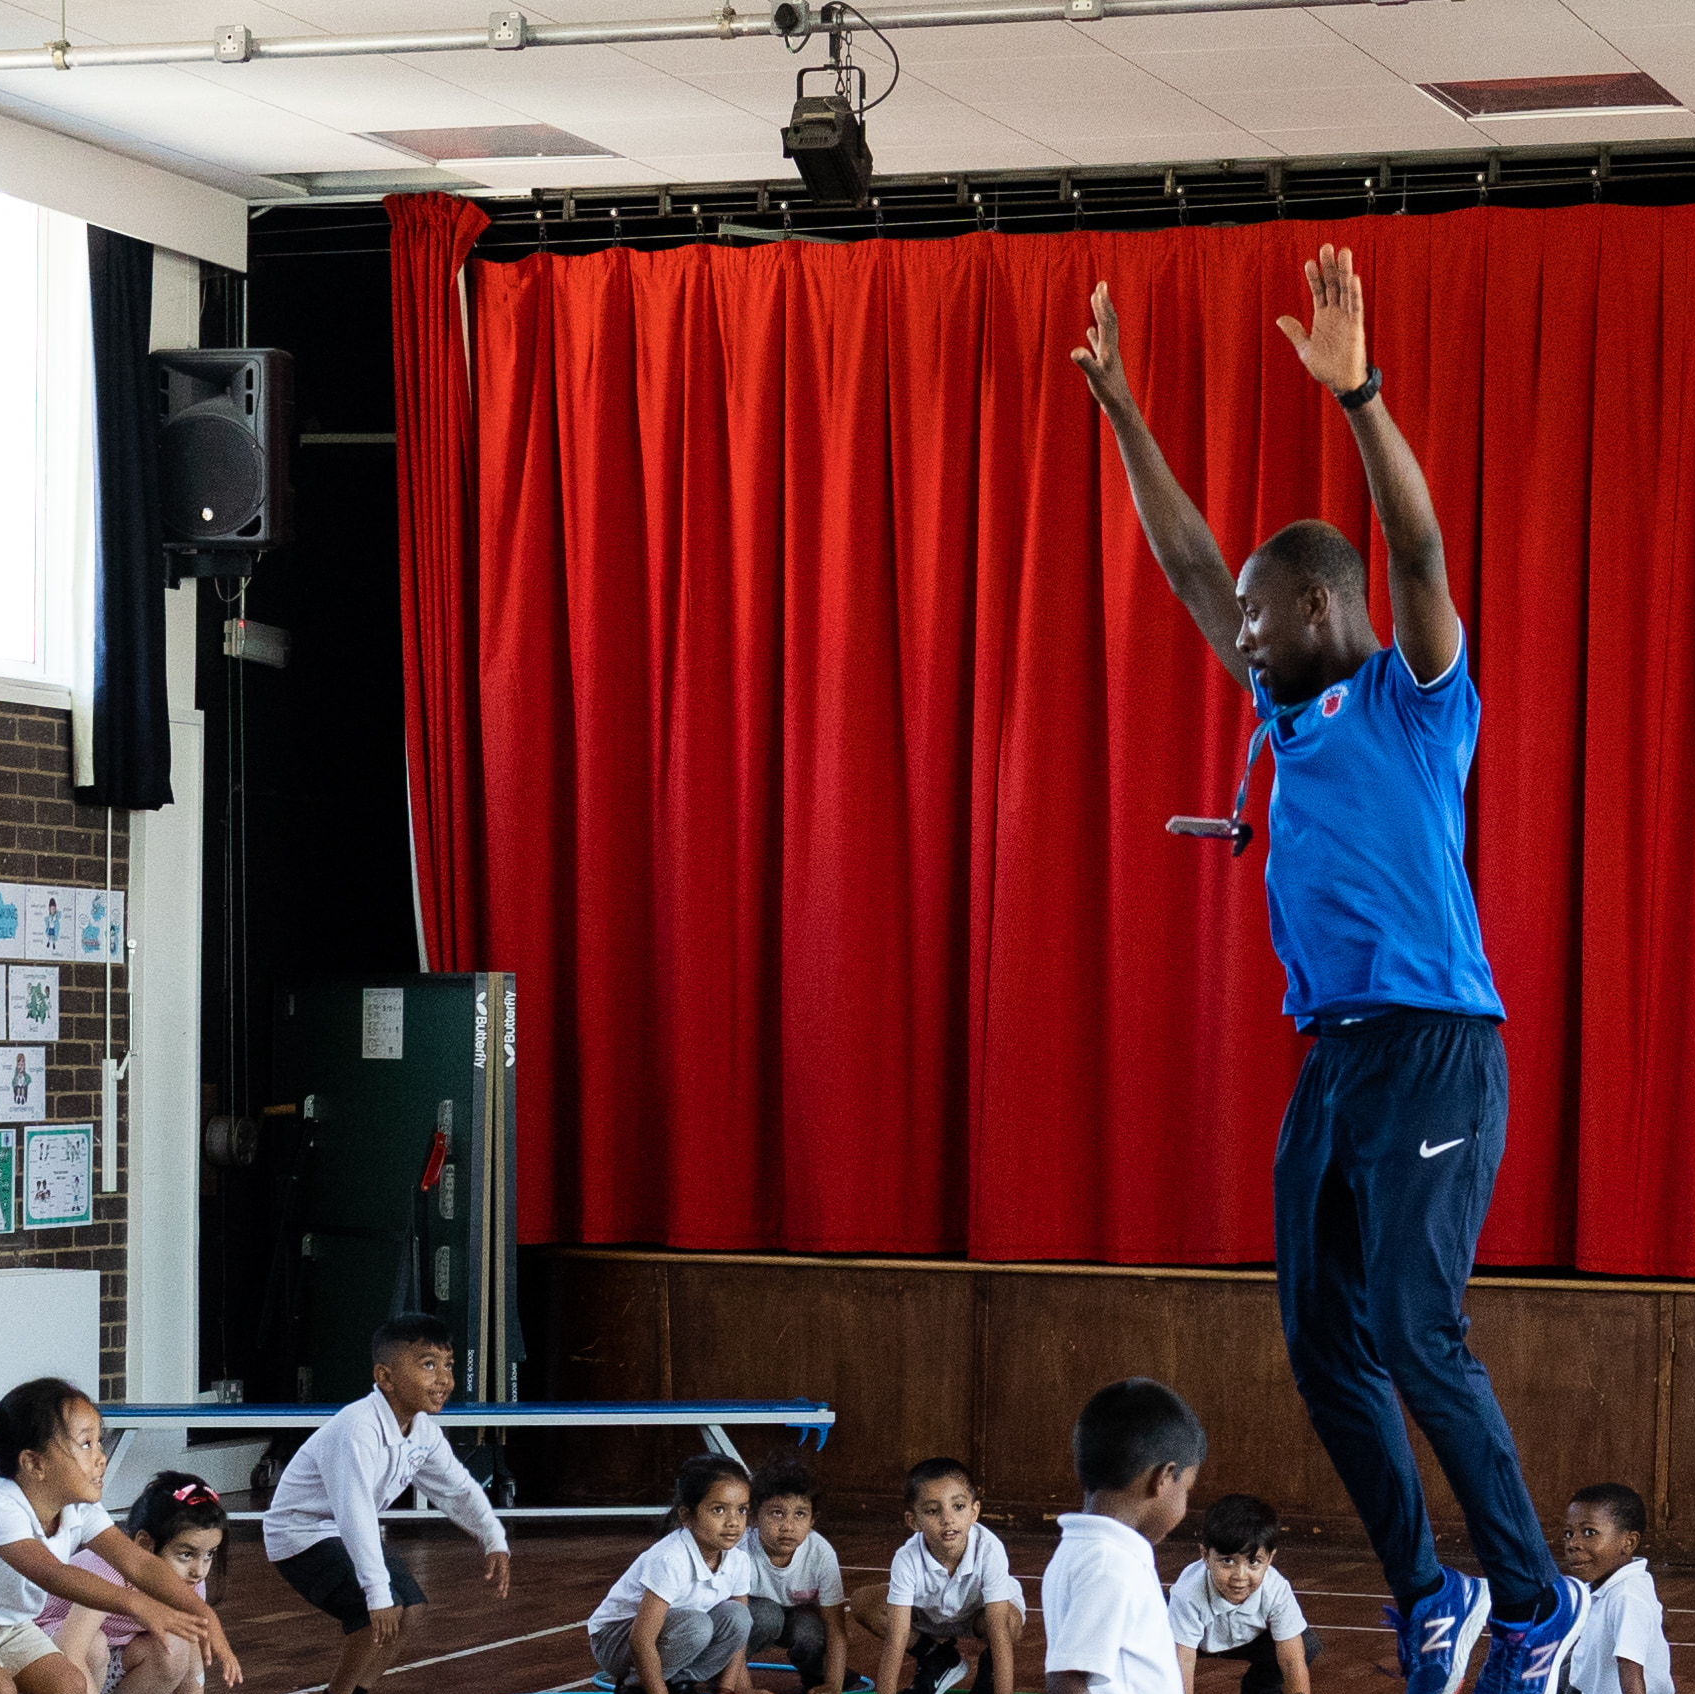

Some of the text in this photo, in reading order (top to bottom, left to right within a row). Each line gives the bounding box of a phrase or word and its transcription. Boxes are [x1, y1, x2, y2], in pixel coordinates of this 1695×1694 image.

[474, 1016, 488, 1069] Butterfly
[504, 991, 516, 1043] Butterfly
[1421, 1616, 1456, 1653] N
